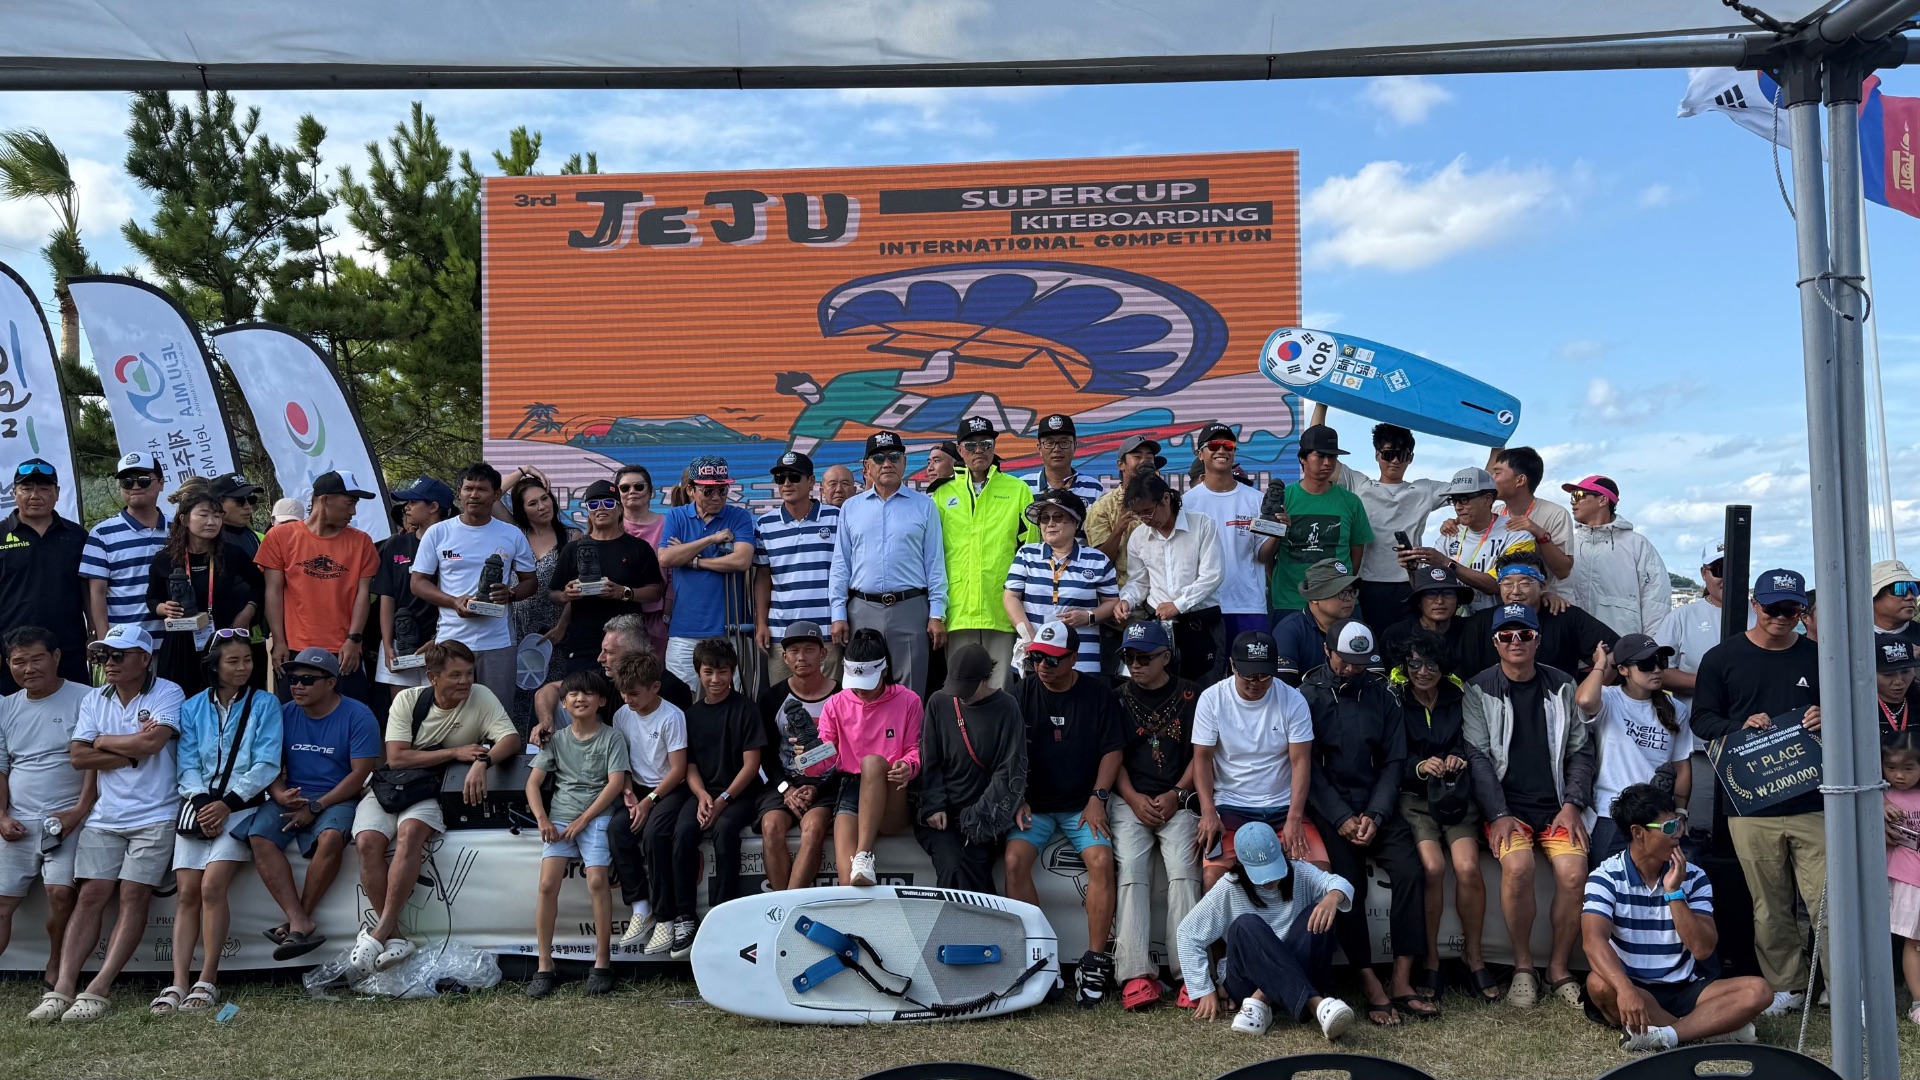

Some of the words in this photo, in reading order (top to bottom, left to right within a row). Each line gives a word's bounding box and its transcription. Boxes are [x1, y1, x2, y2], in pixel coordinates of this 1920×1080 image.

[961, 182, 1198, 209] SUPERCUP
[514, 193, 557, 208] 3rd
[567, 189, 857, 250] JEJU
[1020, 206, 1260, 231] KITEBOARDING
[879, 235, 1084, 256] INTERNATIONAL
[1094, 228, 1272, 249] COMPETITION
[1306, 341, 1334, 377] KOR
[1746, 760, 1758, 773] 1st
[1761, 743, 1806, 768] PLACE
[579, 921, 630, 936] INER
